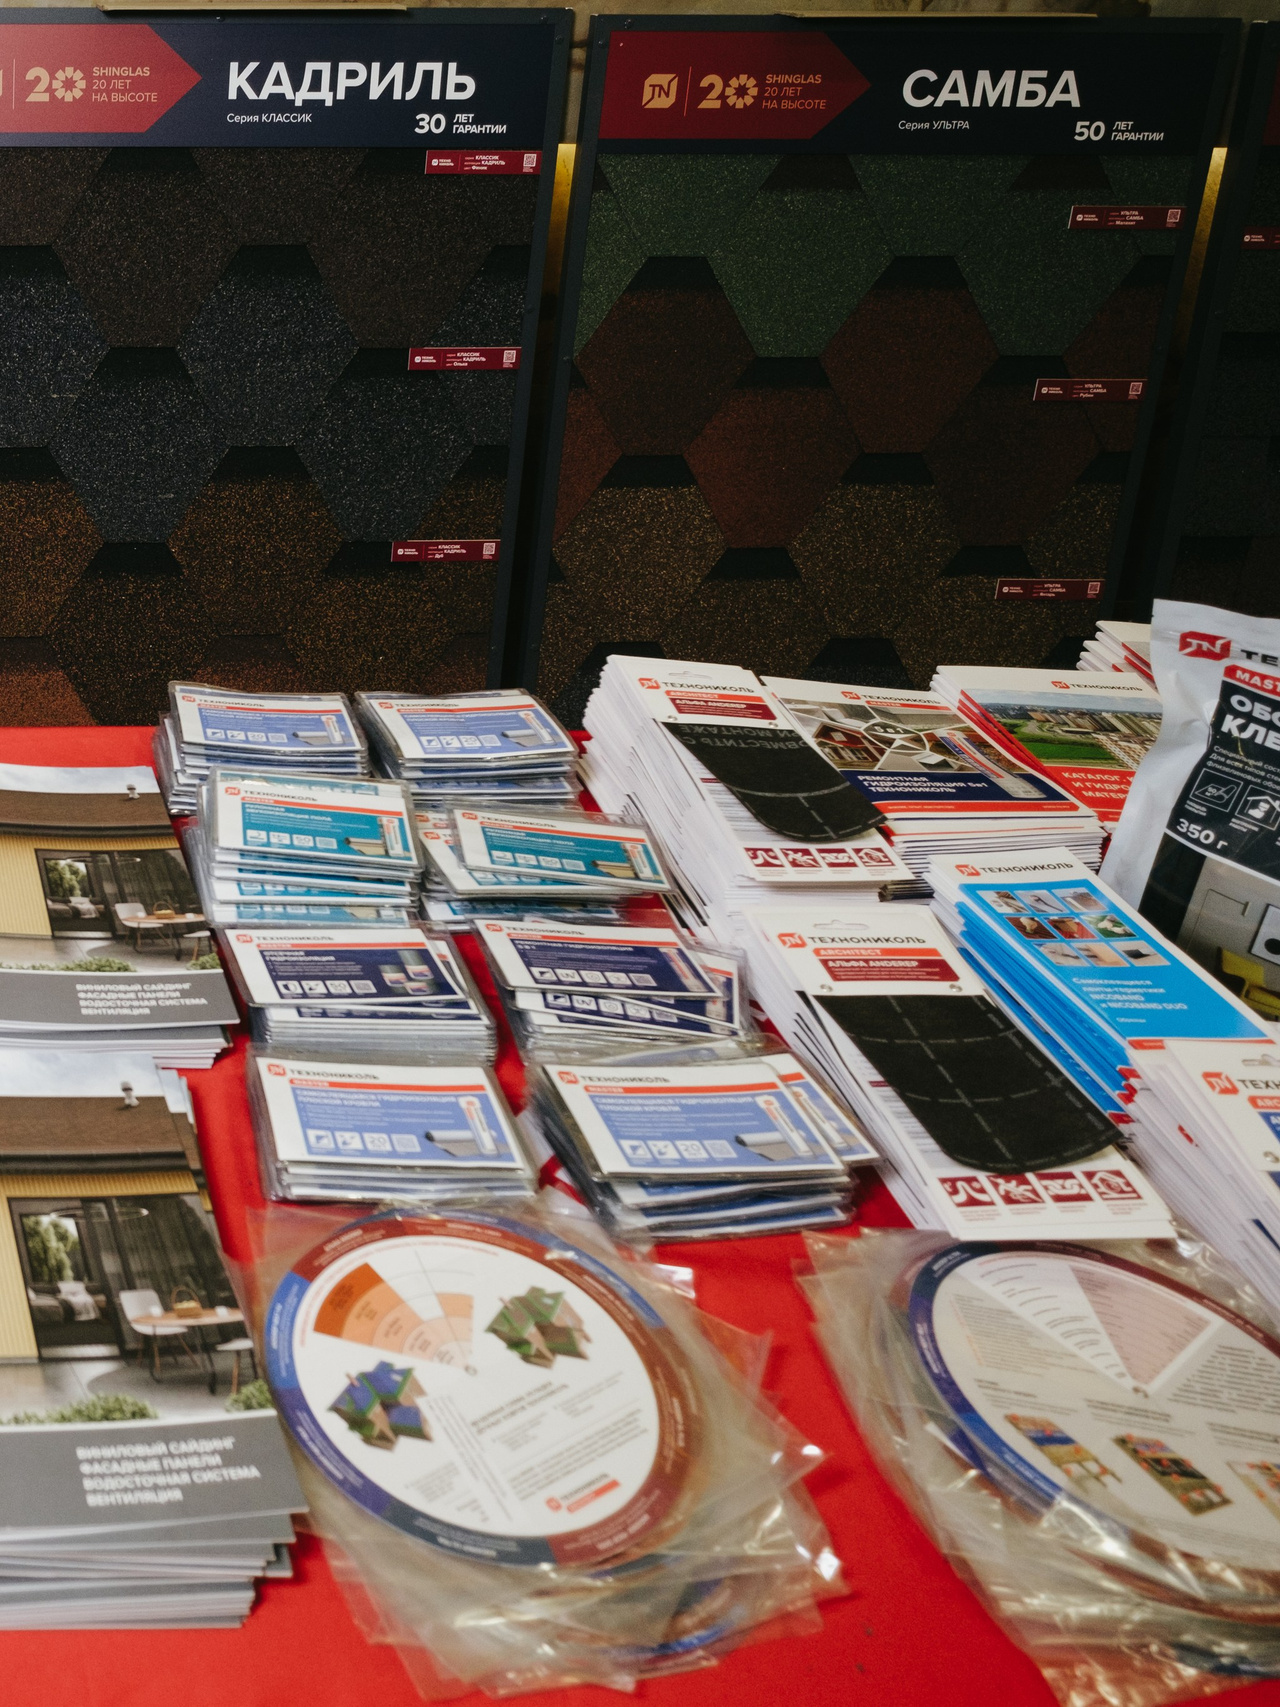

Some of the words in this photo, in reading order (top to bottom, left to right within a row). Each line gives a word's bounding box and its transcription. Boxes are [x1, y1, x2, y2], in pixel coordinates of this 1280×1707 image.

[92, 66, 151, 77] SHINGLAS
[92, 79, 107, 90] 20
[109, 79, 132, 90] ЛЕТ
[227, 61, 476, 106] КАДРИЛЬ
[765, 74, 822, 84] SHINGLAS
[764, 86, 779, 97] 20
[780, 86, 802, 97] ЛЕТ
[902, 69, 1081, 108] САМБА
[92, 92, 110, 102] НА
[111, 92, 158, 102] ВЫСОТЕ
[762, 99, 778, 109] НА
[780, 99, 826, 109] ВЫСОТЕ
[226, 113, 259, 125] Серия
[261, 113, 312, 123] КЛАССИК
[414, 113, 446, 134] 30
[453, 113, 474, 123] ЛЕТ
[452, 124, 507, 134] ГАРАНТИИ
[898, 120, 930, 132] Серия
[932, 120, 970, 130] УЛЬТРА
[1074, 121, 1106, 141] 50
[1112, 121, 1134, 131] ЛЕТ
[1111, 132, 1164, 142] ГАРАНТИИ
[662, 681, 755, 693] ТЕХНОНИКОЛЬ
[1070, 683, 1144, 692] ТЕХНОНИКОЛЬ
[861, 694, 941, 705] ТЕХНОНИКОЛЬ
[1209, 753, 1226, 764] Для
[857, 775, 929, 783] РЕМОНТНАЯ
[242, 789, 318, 802] ТЕХНОНИКОЛЬ
[1176, 817, 1216, 845] 350
[1216, 839, 1229, 850] г
[980, 862, 1075, 875] ТЕХНОНИКОЛЬ
[807, 936, 927, 945] ТЕХНОНИКОЛЬ
[827, 960, 868, 968] АЛЬФА
[289, 1067, 380, 1081] ТЕХНОНИКОЛЬ
[581, 1074, 670, 1084] ТЕХНОНИКОЛЬ
[76, 1441, 167, 1461] ВИНИЛОВЫЙ
[167, 1436, 236, 1455] САЙДИНГ
[78, 1457, 161, 1475] ФАСАДНЫЕ
[161, 1453, 224, 1470] ПАНЕЛИ
[81, 1472, 191, 1491] ВОДОСТОЧНАЯ
[192, 1465, 261, 1485] СИСТЕМА
[85, 1488, 184, 1507] ВЕНТИЛЯЦИЯ
